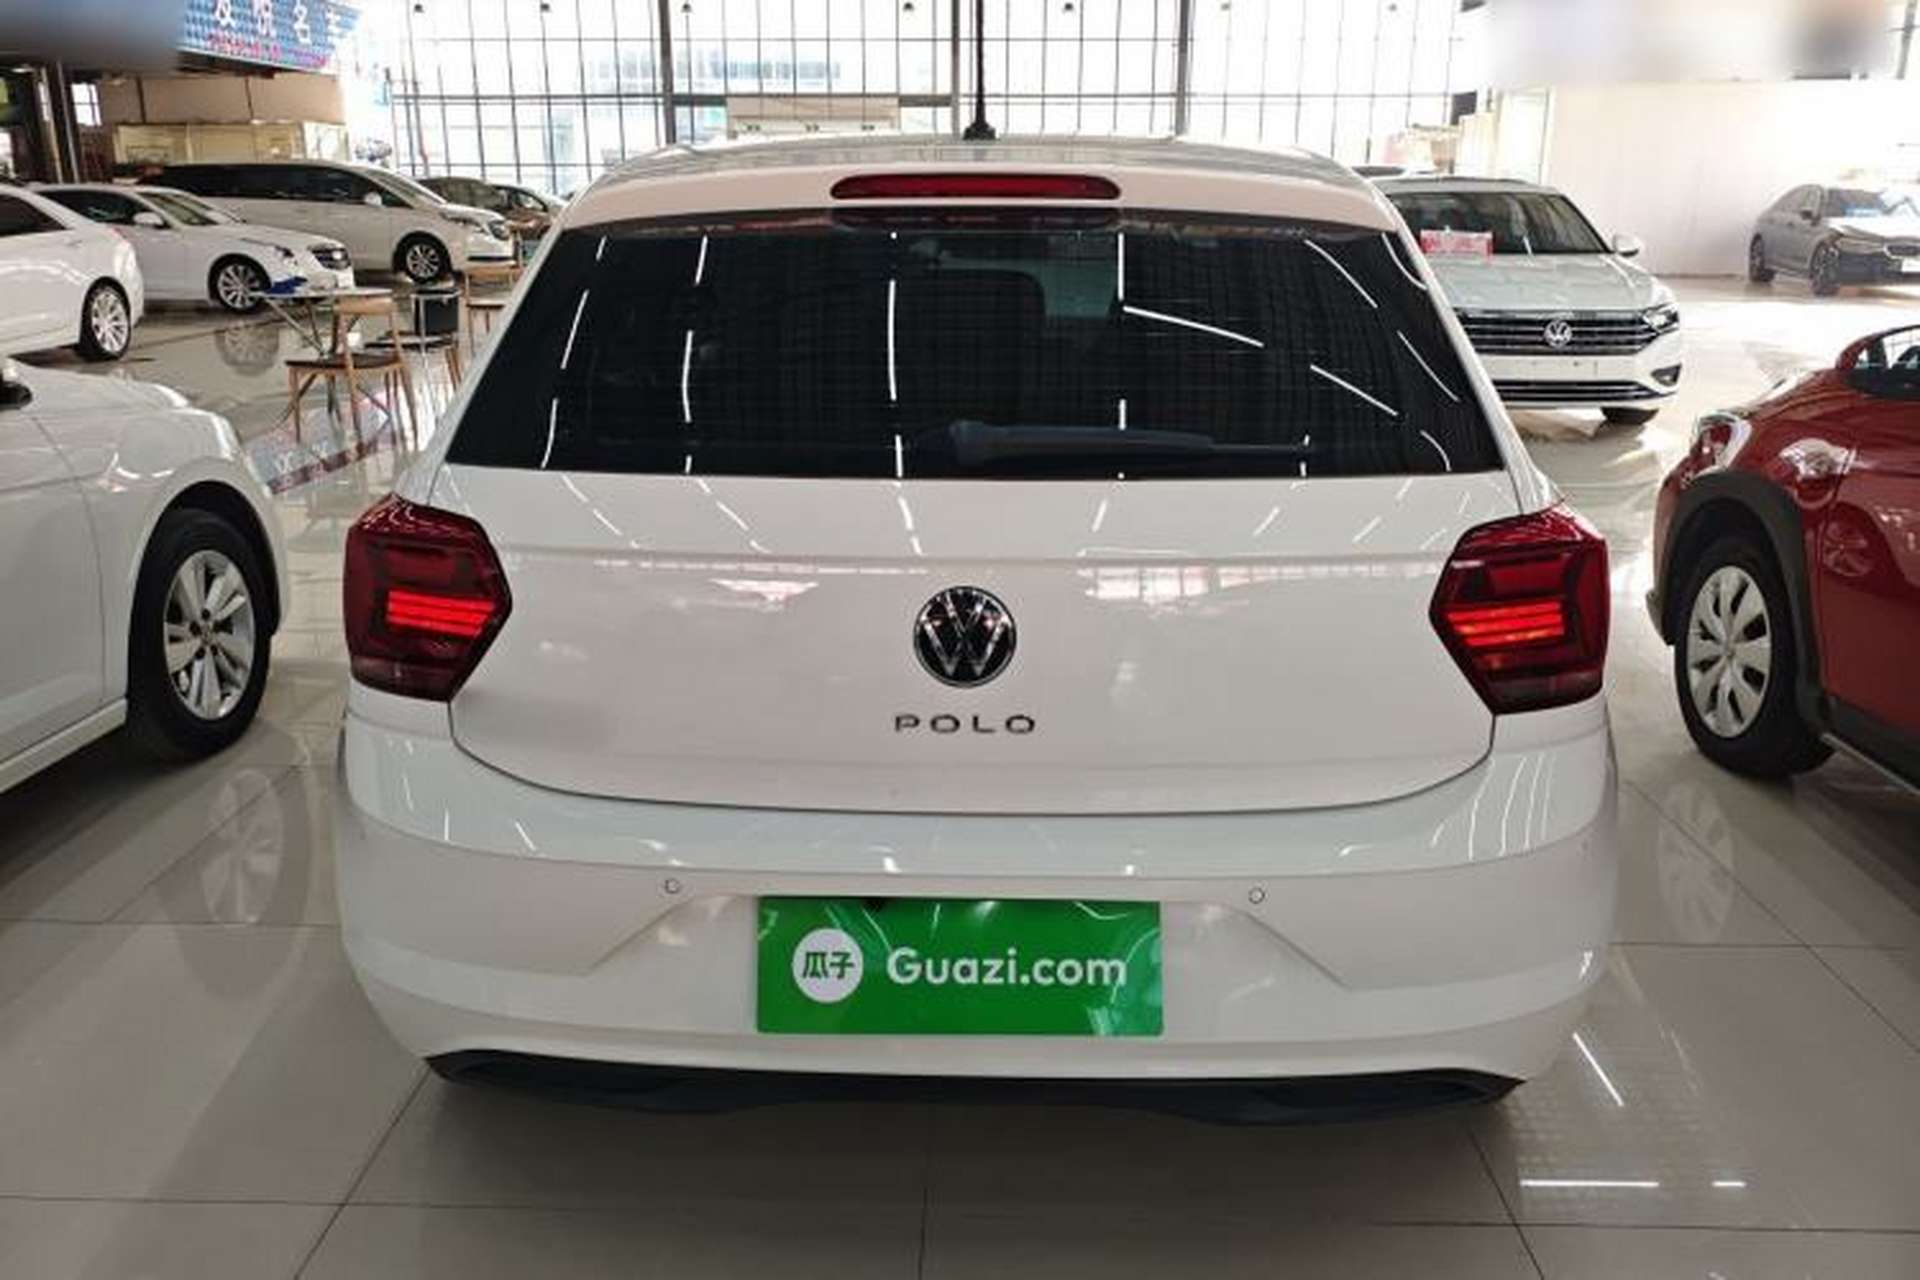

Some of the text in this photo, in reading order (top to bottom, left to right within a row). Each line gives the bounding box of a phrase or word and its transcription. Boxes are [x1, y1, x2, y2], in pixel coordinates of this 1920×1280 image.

[894, 713, 1036, 735] POLO
[801, 951, 855, 980] 瓜子
[886, 946, 1128, 986] Guazi.com
